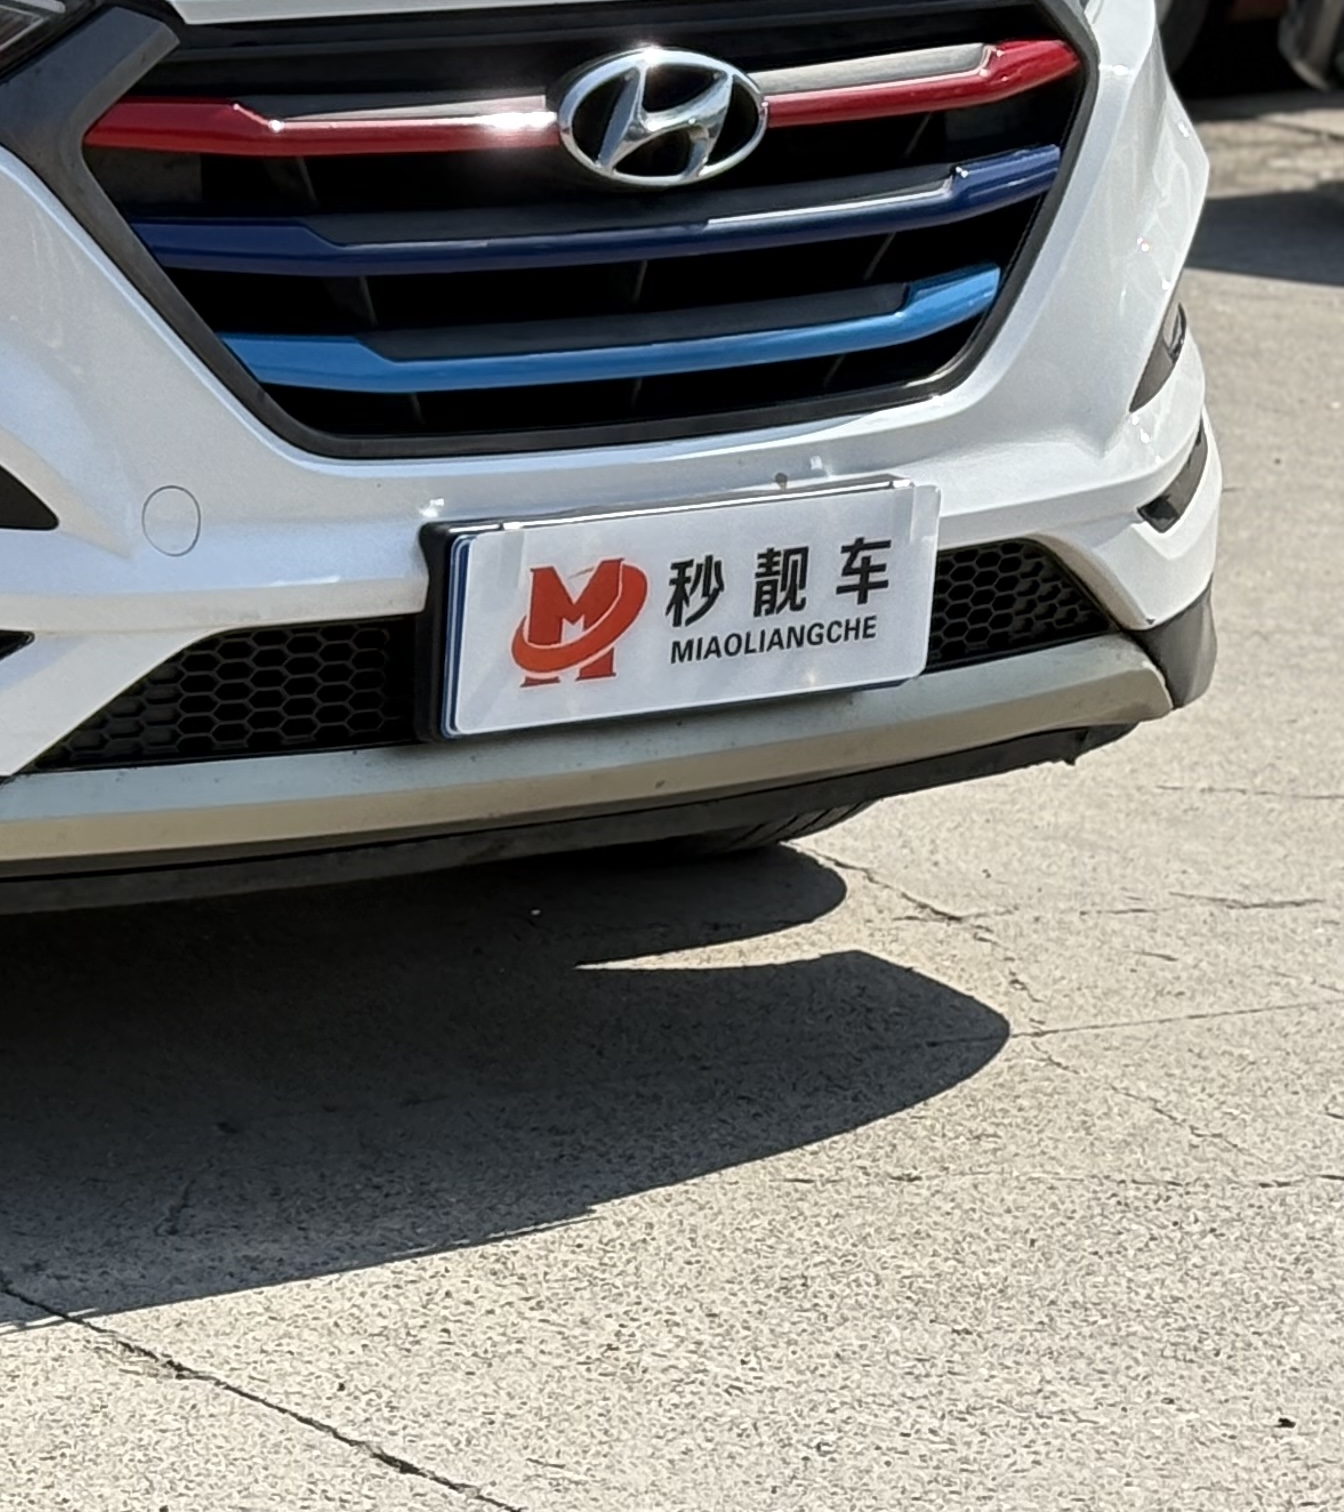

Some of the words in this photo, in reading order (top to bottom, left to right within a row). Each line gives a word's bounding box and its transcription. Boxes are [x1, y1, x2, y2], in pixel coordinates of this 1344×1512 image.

[666, 538, 891, 627] 秒靓车
[670, 616, 877, 665] MIAOLIANGCHE
